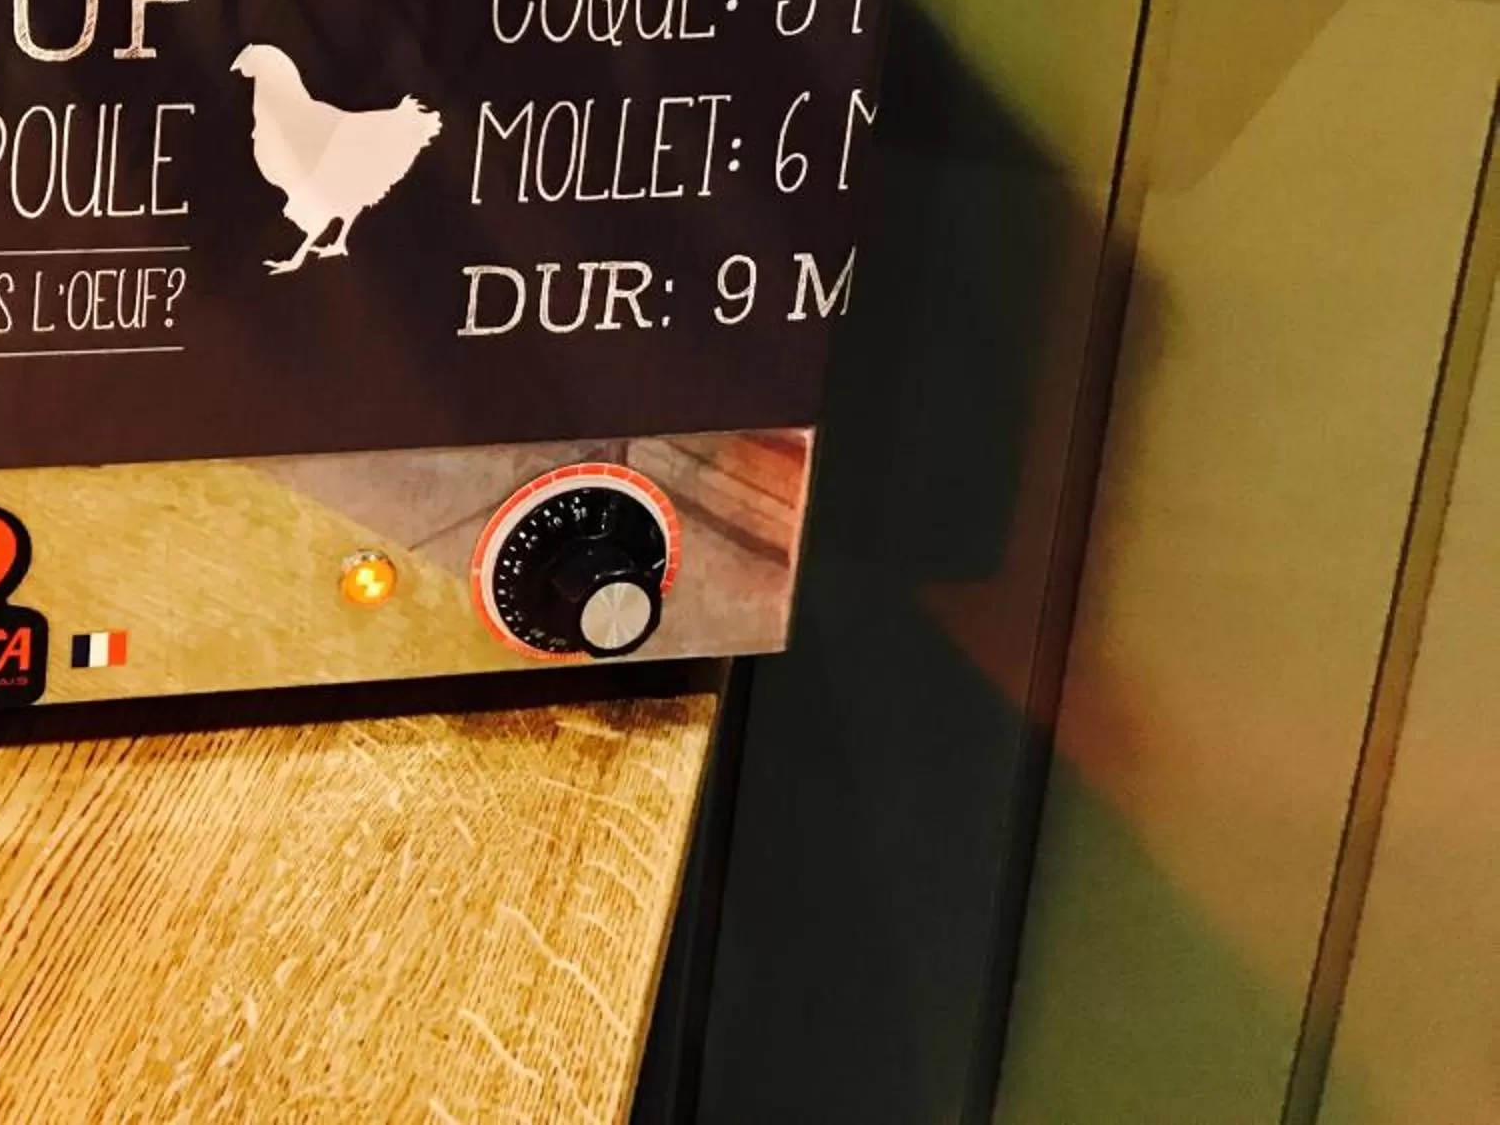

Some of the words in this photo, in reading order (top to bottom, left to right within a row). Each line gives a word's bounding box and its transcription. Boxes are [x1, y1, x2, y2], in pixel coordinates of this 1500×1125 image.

[470, 93, 743, 206] MOLLET:
[774, 90, 811, 194] 6
[31, 267, 188, 333] L'OEUF?
[456, 259, 675, 338] DUR:
[713, 253, 758, 326] 9
